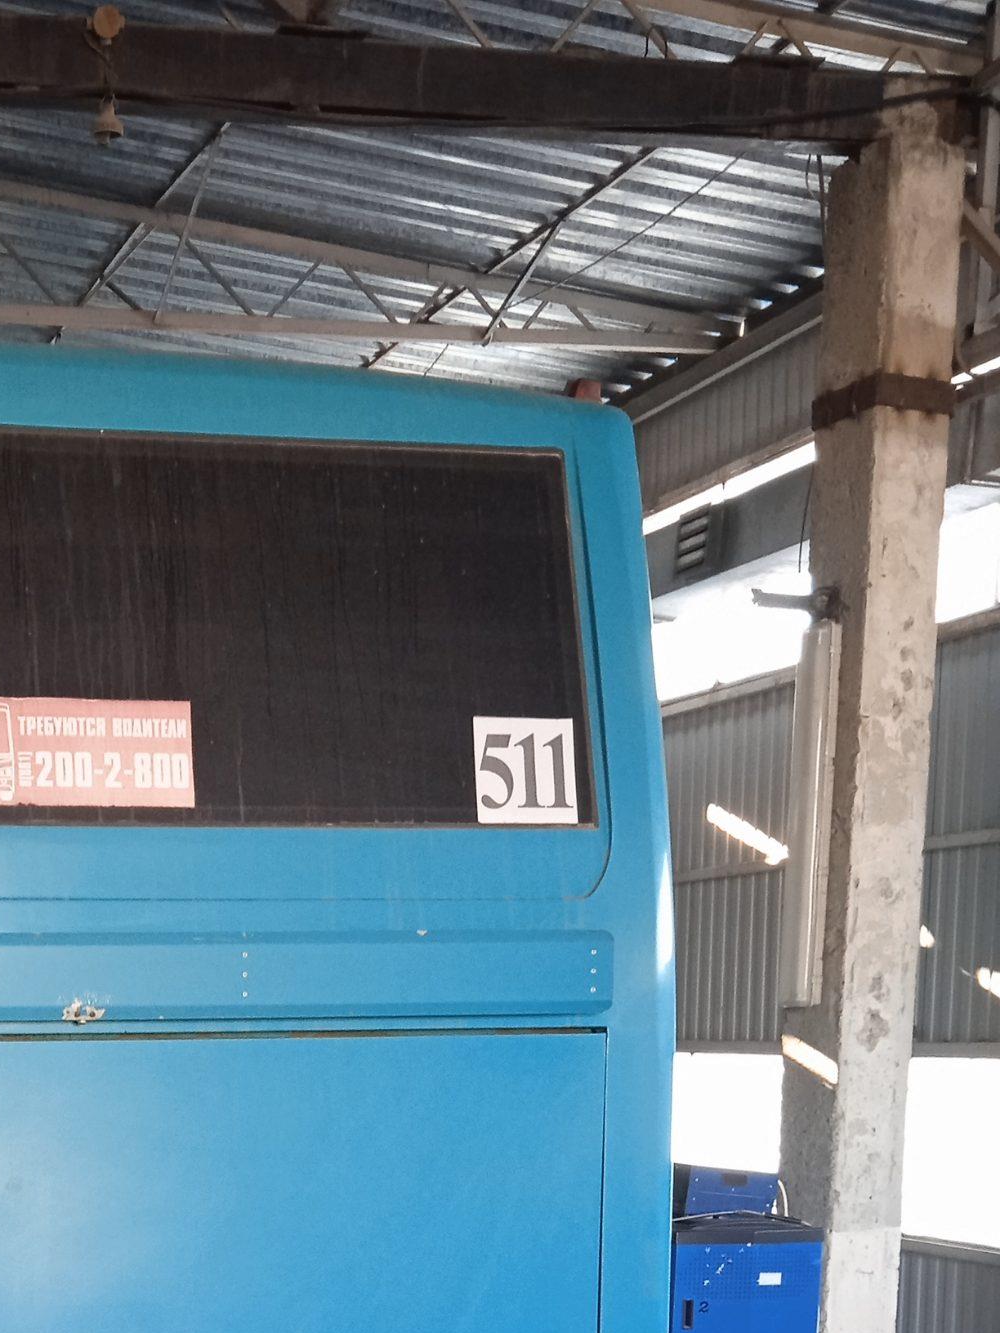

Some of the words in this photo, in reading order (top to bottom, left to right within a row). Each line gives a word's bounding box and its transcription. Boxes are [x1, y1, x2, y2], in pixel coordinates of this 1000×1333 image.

[17, 715, 106, 737] ТРЕБУЮТСЯ
[112, 717, 187, 739] ВОДИТЕЛИ
[35, 751, 190, 789] 200-2-800
[480, 733, 574, 809] 511
